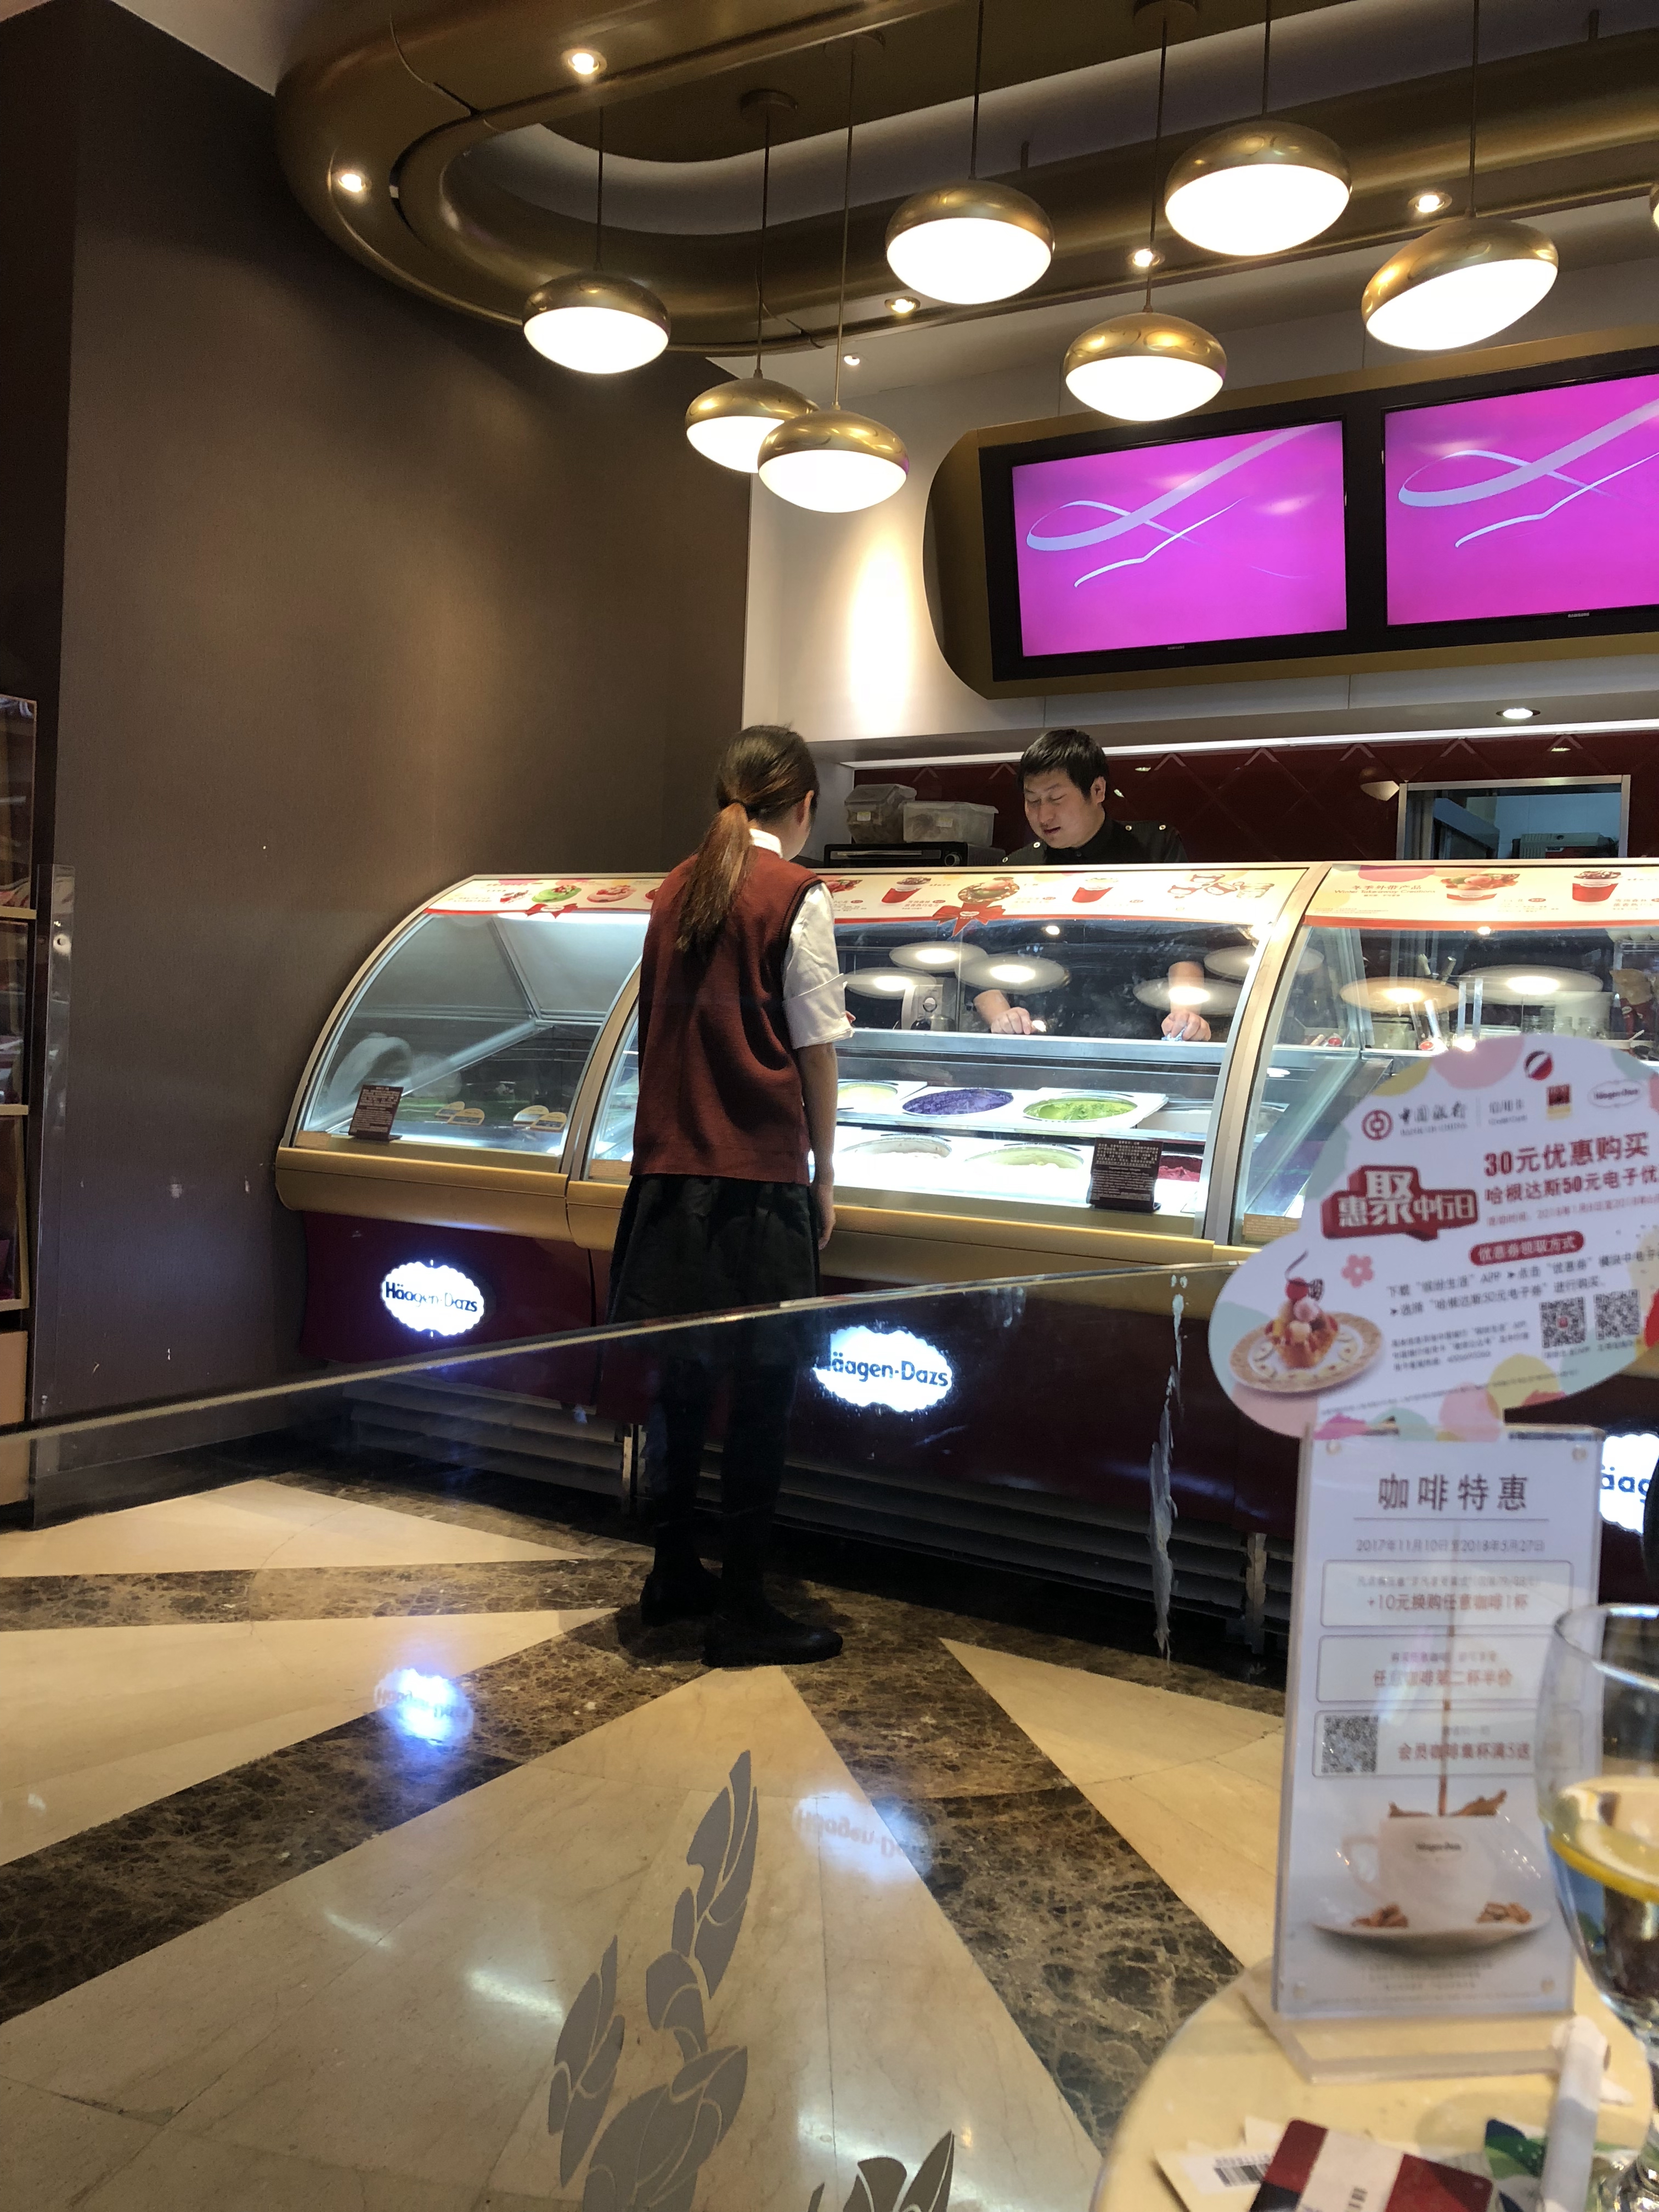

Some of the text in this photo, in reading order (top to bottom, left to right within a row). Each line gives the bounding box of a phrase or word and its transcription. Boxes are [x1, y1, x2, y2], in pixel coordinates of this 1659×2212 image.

[1484, 1132, 1649, 1177] 30元优惠购买
[1485, 1165, 1658, 1205] 哈根达斯50元电子优
[386, 1281, 478, 1312] Häagen-Dazs
[823, 1351, 949, 1387] äagen-Dazs
[1378, 1472, 1528, 1511] 咖啡特惠
